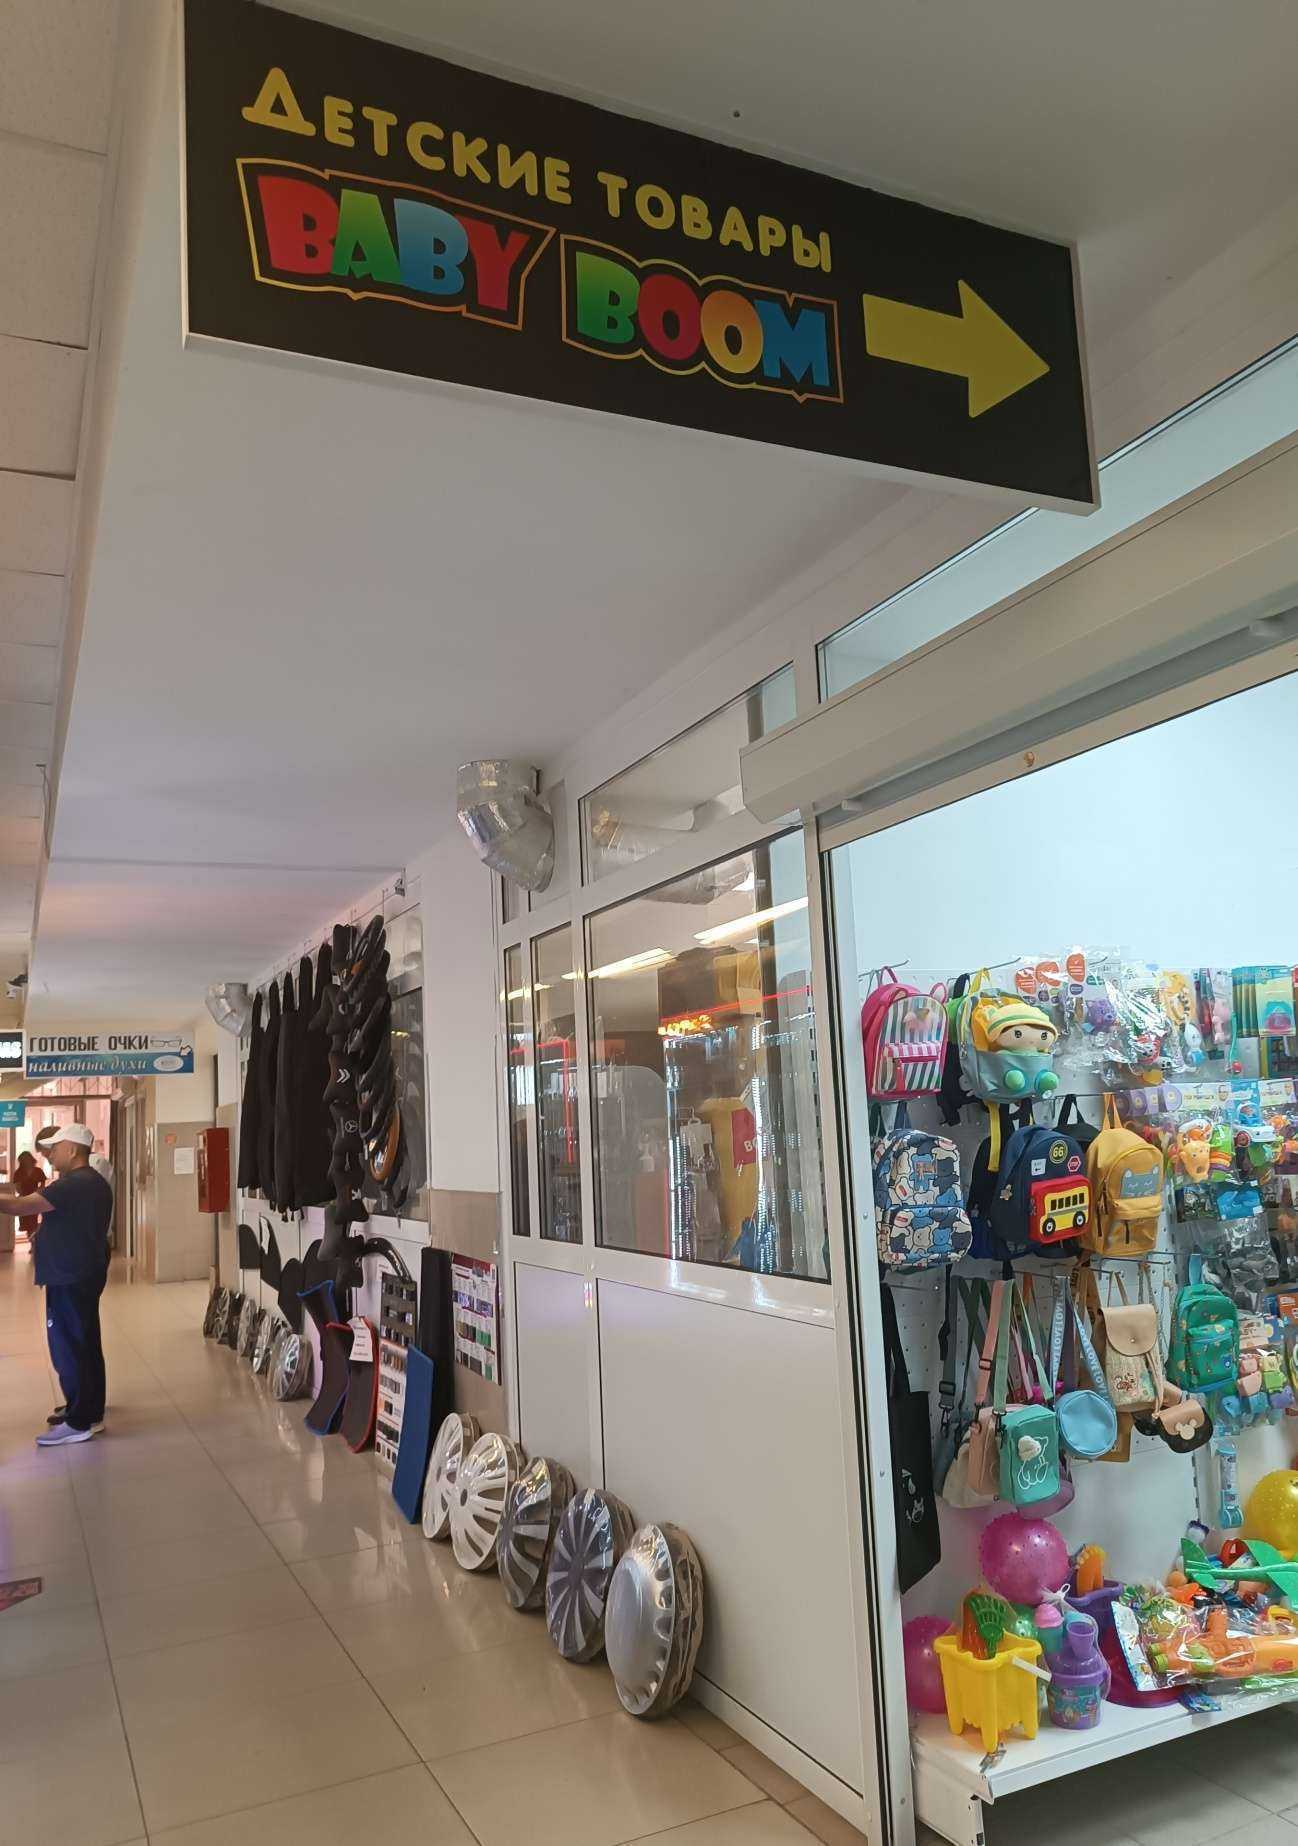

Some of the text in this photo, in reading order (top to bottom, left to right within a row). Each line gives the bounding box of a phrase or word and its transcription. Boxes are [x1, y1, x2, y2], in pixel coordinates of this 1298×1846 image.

[241, 67, 832, 273] ДЕТСКИЕ ТОВАРЫ
[257, 174, 831, 388] BABY BOOM
[30, 1036, 99, 1052] ГОТОВЫЕ
[108, 1035, 148, 1050] ОЧКИ
[1053, 1146, 1064, 1157] 66
